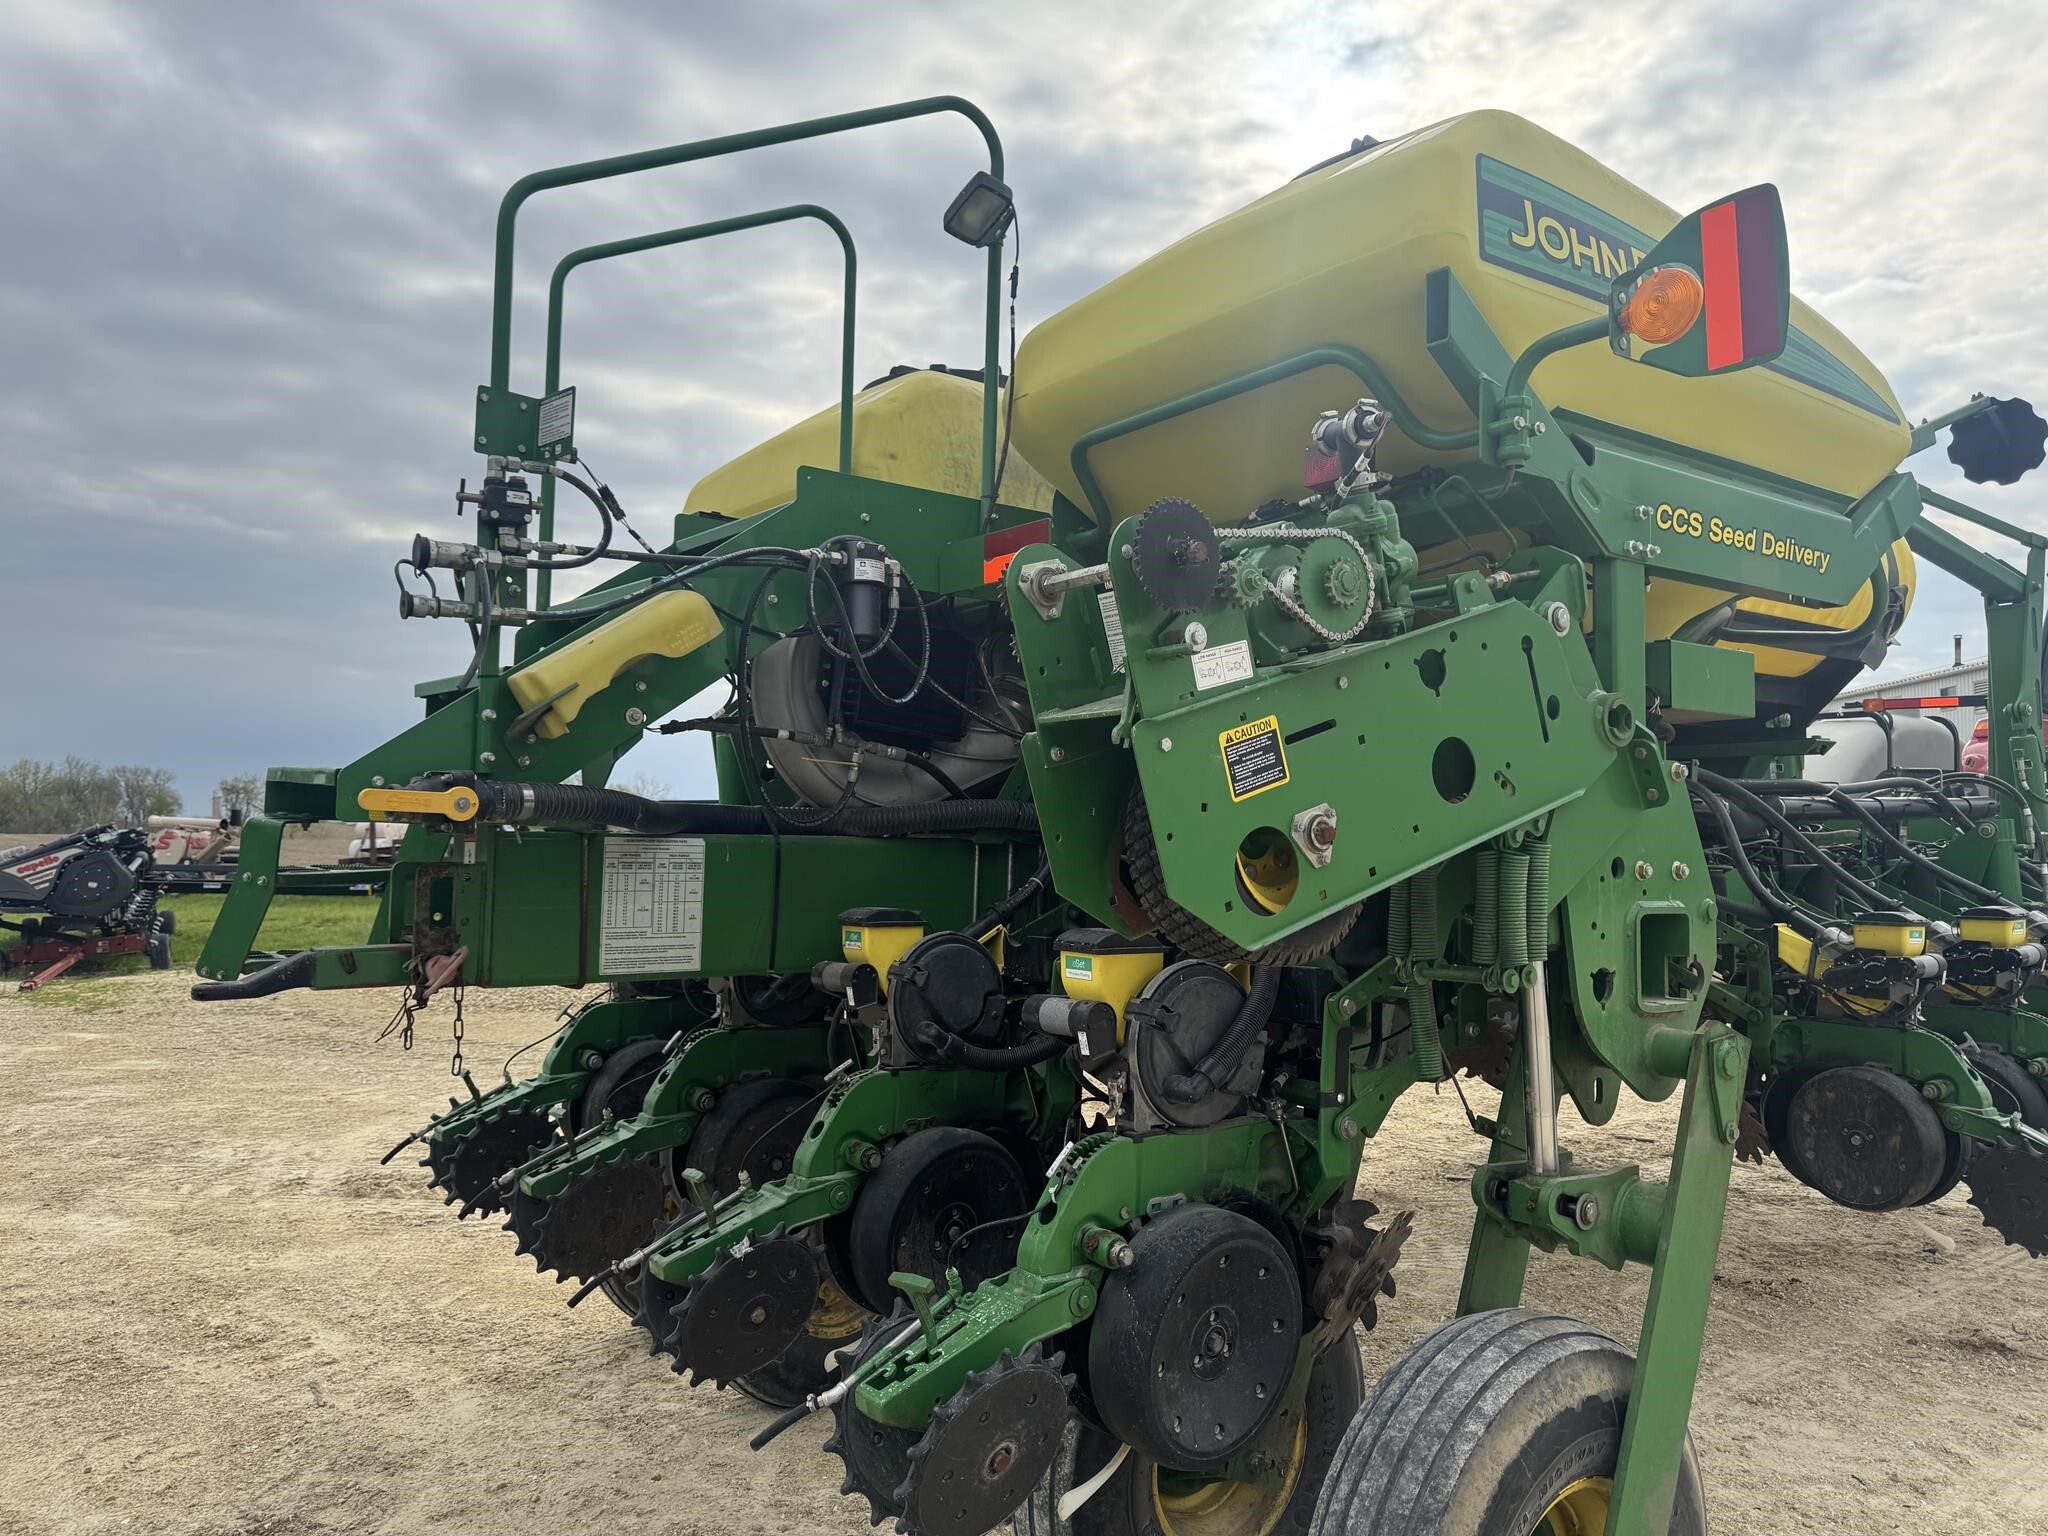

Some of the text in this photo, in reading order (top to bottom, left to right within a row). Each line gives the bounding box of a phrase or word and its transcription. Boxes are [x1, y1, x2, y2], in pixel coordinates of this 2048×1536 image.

[1511, 199, 1628, 278] JOHN
[1656, 503, 1831, 575] CCS Seed Delivery
[1234, 719, 1272, 741] CAUTION
